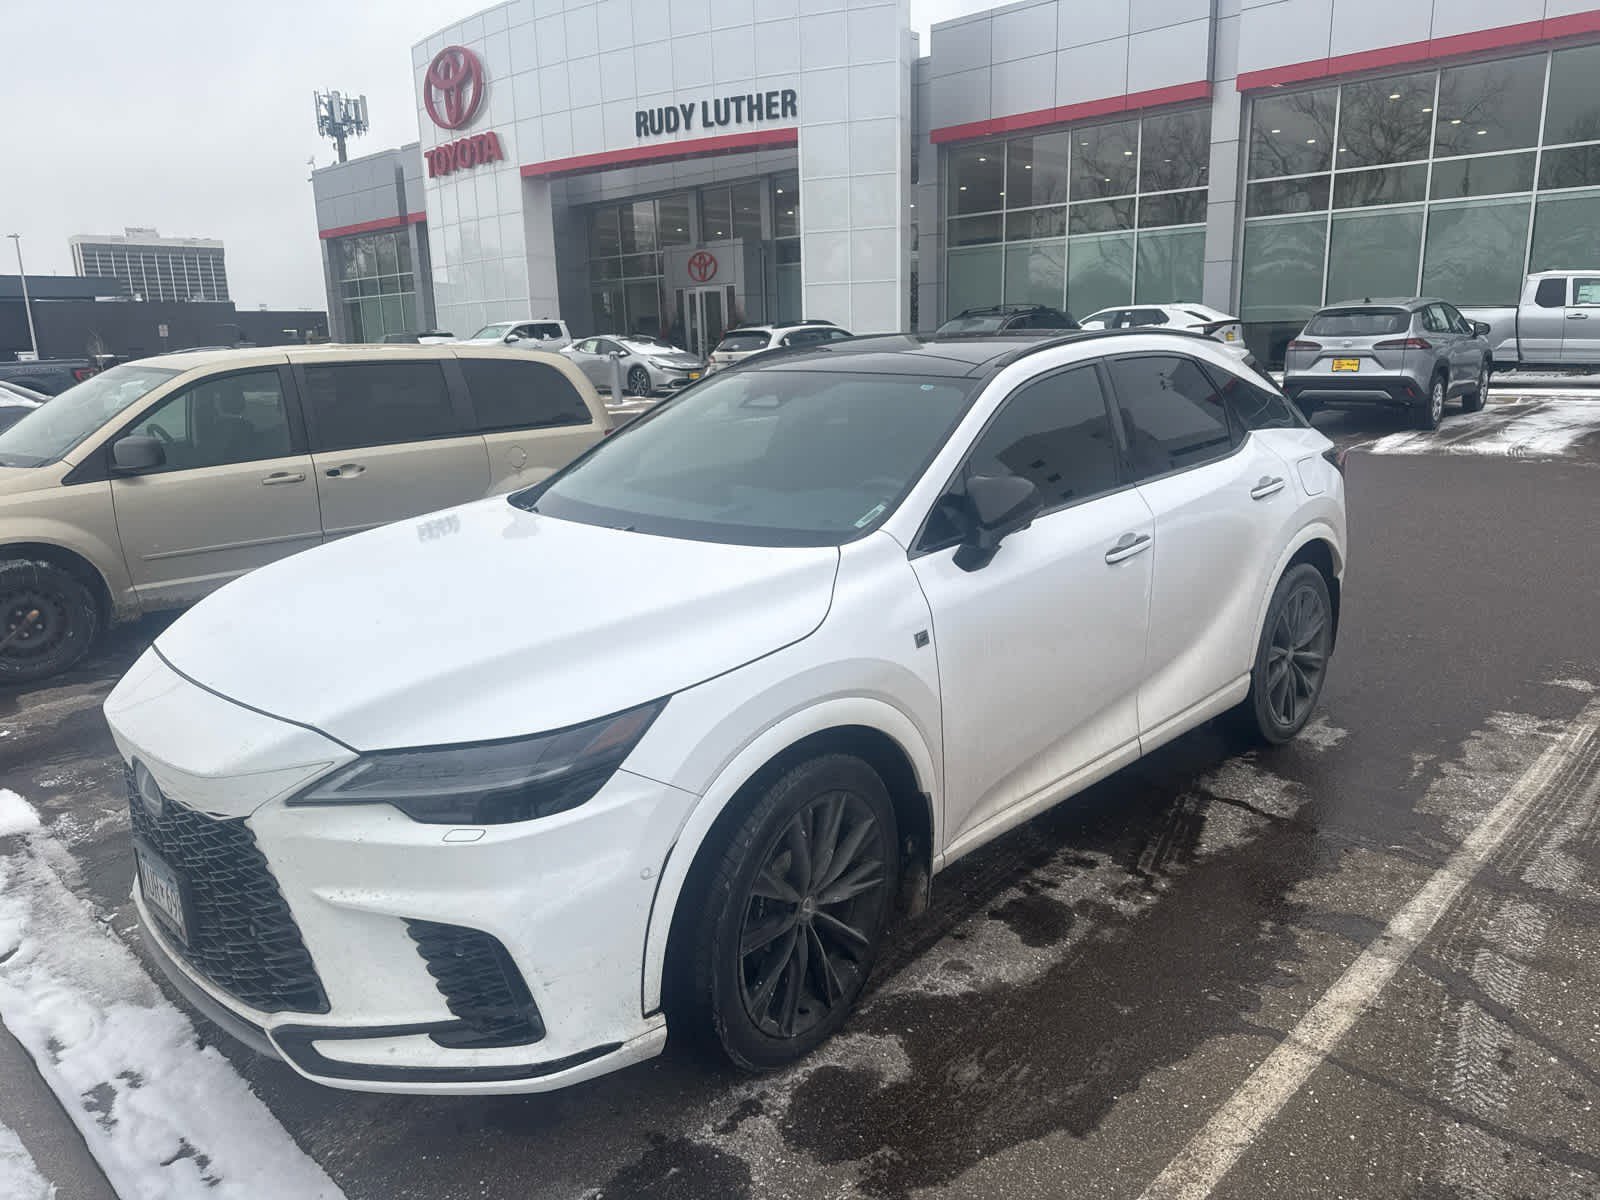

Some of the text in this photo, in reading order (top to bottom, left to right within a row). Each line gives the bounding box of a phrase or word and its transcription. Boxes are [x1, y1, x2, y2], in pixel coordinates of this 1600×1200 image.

[635, 89, 797, 137] RUDY LUTHER
[424, 132, 504, 178] TOYOTA
